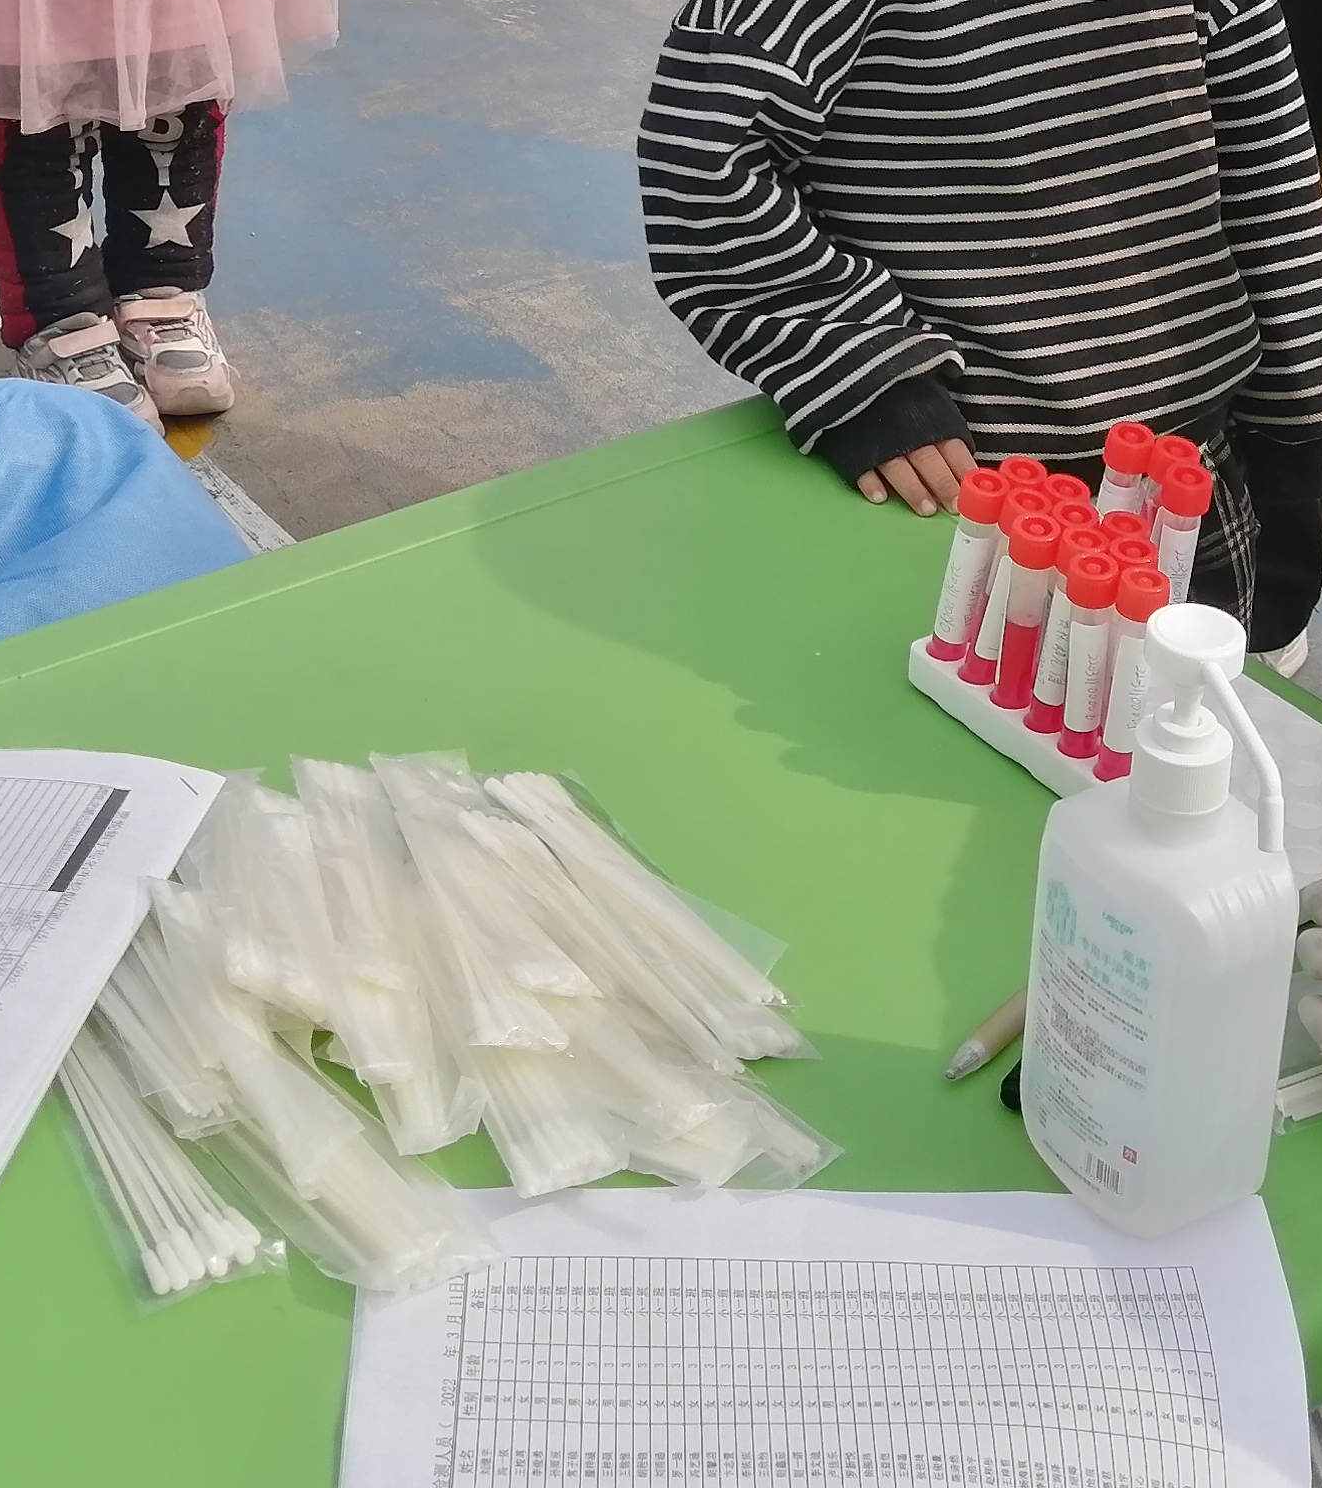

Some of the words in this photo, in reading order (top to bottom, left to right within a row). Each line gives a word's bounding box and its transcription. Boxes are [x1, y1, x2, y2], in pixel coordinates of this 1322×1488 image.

[1125, 1147, 1137, 1162] 外
[470, 1288, 485, 1310] 备注
[488, 1285, 502, 1314] 小一班
[505, 1286, 518, 1313] 小一班
[520, 1286, 534, 1314] 小一班
[538, 1286, 550, 1314] 小一班
[555, 1286, 567, 1315] 小一班
[571, 1286, 583, 1316] 小一班
[587, 1287, 599, 1316] 小一班
[602, 1287, 615, 1316] 小一班
[619, 1287, 632, 1316] 小一班
[636, 1287, 648, 1317] 小一班
[653, 1287, 665, 1317] 小一班
[669, 1288, 681, 1317] 小一班
[686, 1288, 697, 1318] 小一班
[701, 1289, 713, 1318] 小一班
[717, 1289, 729, 1318] 小一班
[733, 1289, 745, 1318] 小一班
[749, 1290, 761, 1319] 小一班
[765, 1290, 778, 1319] 小一班
[781, 1291, 795, 1318] 小一班
[798, 1290, 809, 1319] 小一班
[814, 1290, 826, 1320] 小一班
[830, 1290, 844, 1320] 小一班
[846, 1290, 860, 1320] 小二班
[863, 1290, 877, 1320] 小二班
[879, 1288, 893, 1320] 小二班
[895, 1291, 910, 1321] 小二班
[911, 1292, 926, 1320] 小二班
[927, 1292, 942, 1320] 小二班
[944, 1293, 958, 1320] 小二班
[960, 1293, 973, 1320] 小二班
[976, 1293, 991, 1321] 小二班
[992, 1294, 1006, 1321] 小二班
[1008, 1294, 1023, 1321] 小二班
[1024, 1293, 1038, 1321] 小二班
[1040, 1293, 1054, 1320] 小二班
[1056, 1293, 1072, 1320] 小二班
[1073, 1293, 1088, 1320] 小二班
[1089, 1293, 1105, 1320] 小二班
[1105, 1293, 1120, 1320] 小二班
[1122, 1293, 1137, 1320] 小二班
[1138, 1293, 1154, 1320] 小二班
[1154, 1293, 1171, 1320] 小二班
[1170, 1293, 1185, 1320] 小二班
[1186, 1293, 1203, 1320] 小二班
[446, 1314, 462, 1325] 月
[443, 1345, 459, 1358] 年
[466, 1354, 481, 1377] 年龄
[440, 1378, 456, 1407] 2022
[463, 1391, 479, 1416] 性别
[458, 1449, 474, 1474] 姓名
